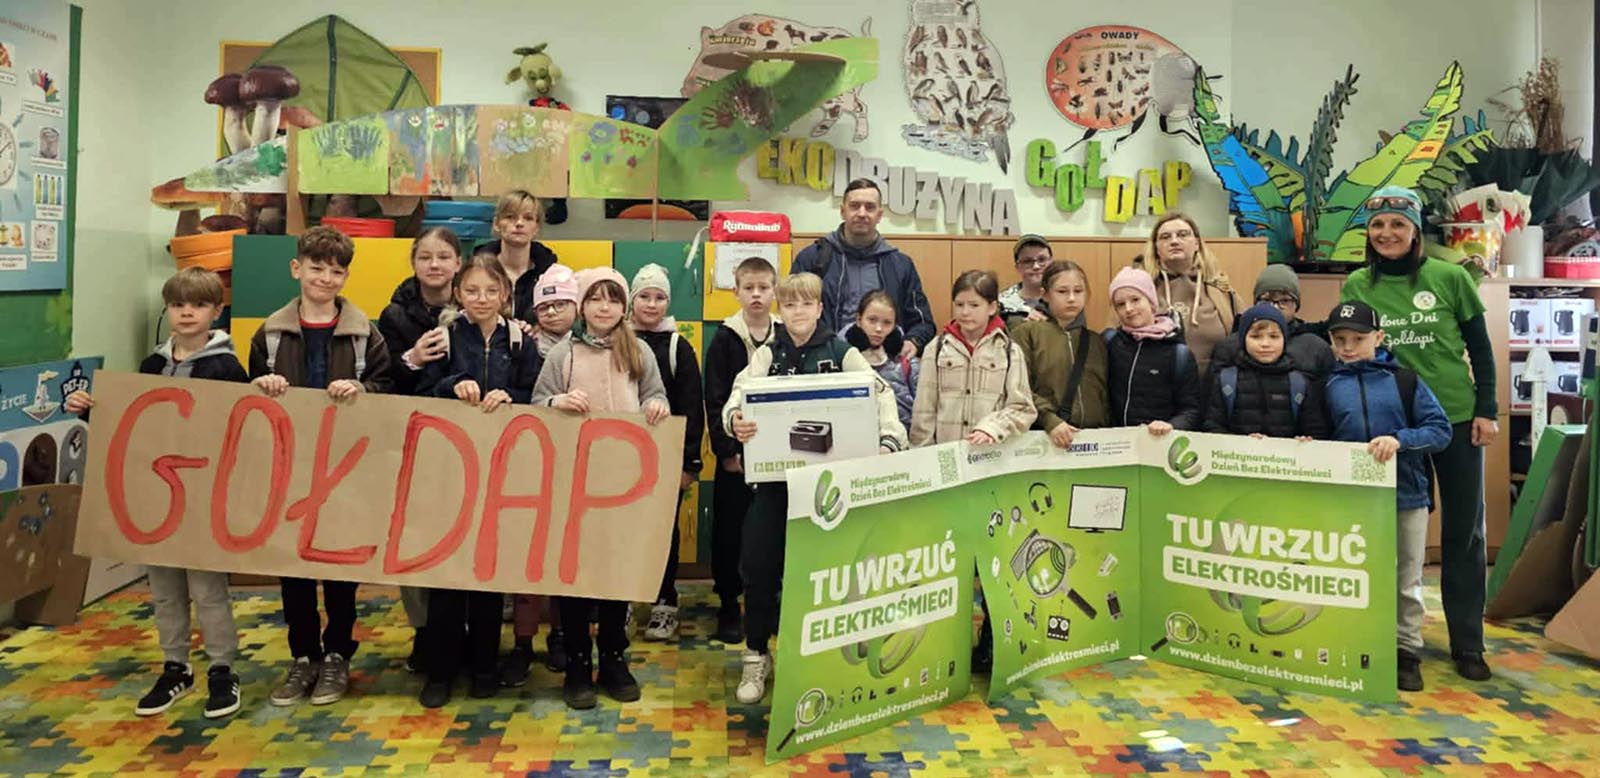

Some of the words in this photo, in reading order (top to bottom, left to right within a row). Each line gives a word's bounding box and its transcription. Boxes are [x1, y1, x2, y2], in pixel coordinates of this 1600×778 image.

[1101, 31, 1140, 40] OWADY
[1380, 313, 1408, 327] lone
[1410, 311, 1439, 324] Dni
[1211, 449, 1297, 467] Międzynarodowy
[1211, 461, 1239, 474] Dzień
[1240, 464, 1260, 474] Bez
[1260, 465, 1332, 479] Elektrośmieci
[105, 387, 659, 584] GOŁDAP
[1166, 513, 1213, 548] TU
[1219, 521, 1367, 565] WRZUĆ
[809, 564, 851, 606] TU
[855, 529, 957, 595] WRZUĆ
[1172, 555, 1361, 598] ELEKTROŚMIECI
[809, 587, 953, 644] ELEKTROŚMIECI
[1168, 644, 1364, 692] www.dzienbezelektrosmieci.pl
